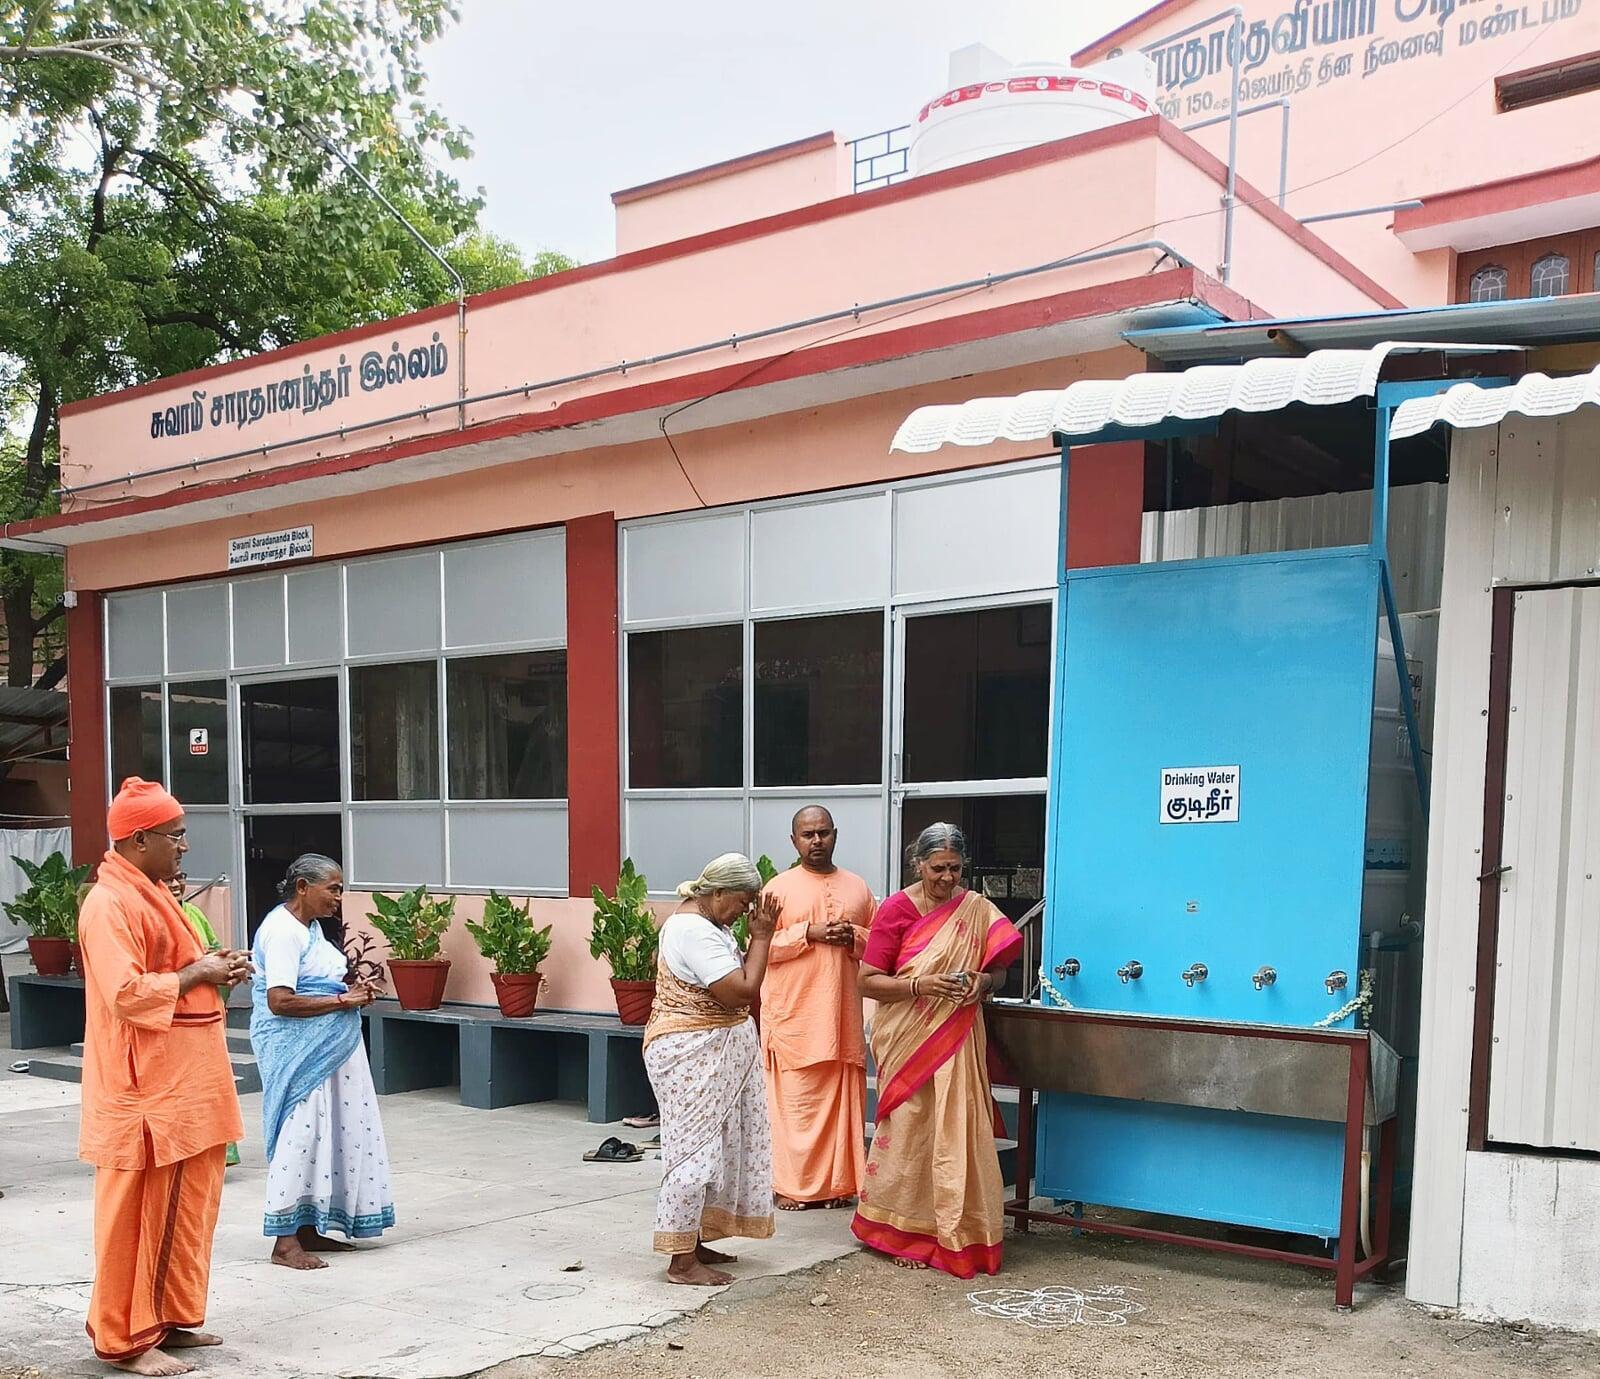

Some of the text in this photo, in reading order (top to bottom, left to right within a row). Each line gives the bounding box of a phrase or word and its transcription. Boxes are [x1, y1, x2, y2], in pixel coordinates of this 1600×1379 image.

[151, 331, 449, 439] சுவாமி சாரதானந்தர் இல்லம்
[232, 529, 310, 551] Swami Saradananda Block
[1164, 771, 1236, 788] Drinking Water
[1166, 788, 1233, 820] குடிநீர்
